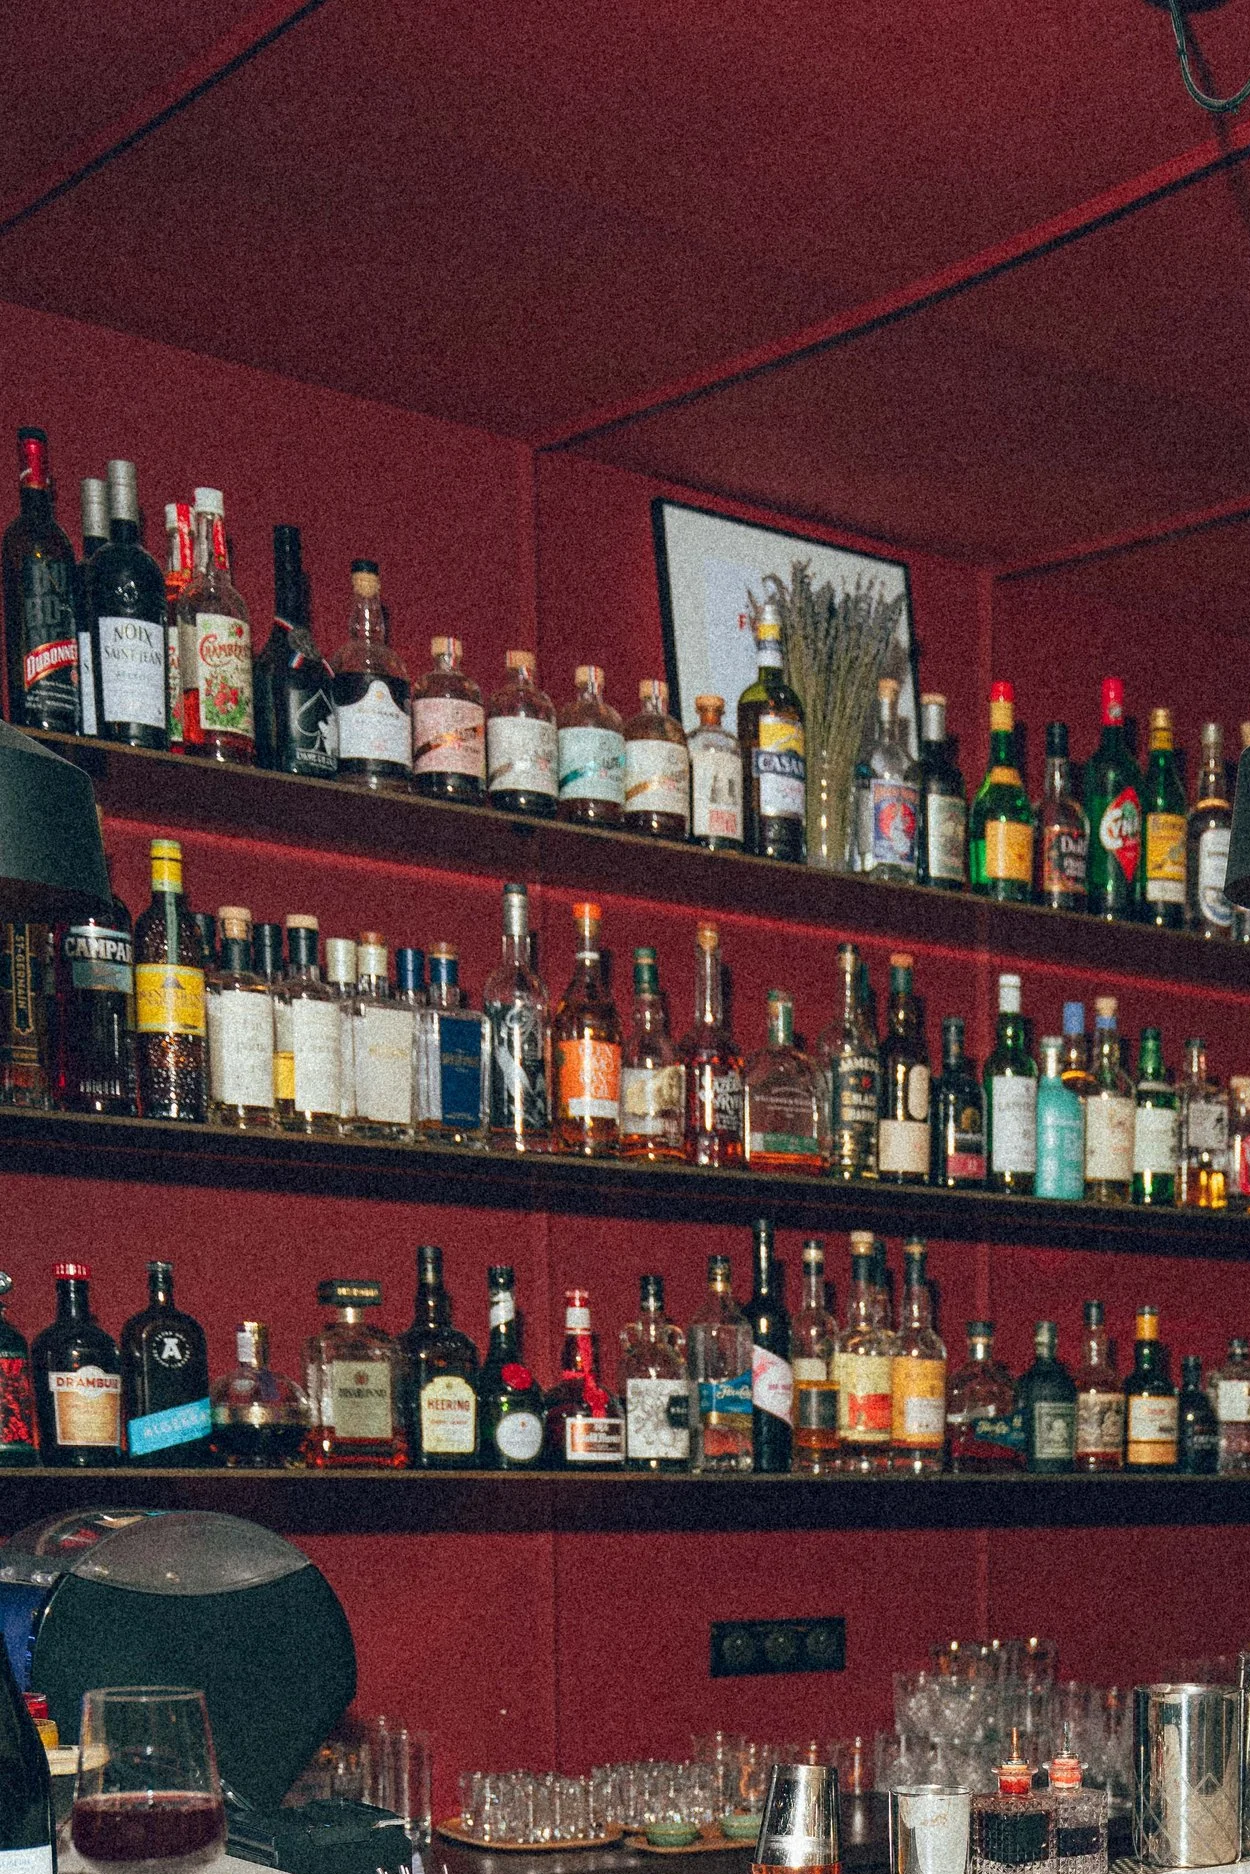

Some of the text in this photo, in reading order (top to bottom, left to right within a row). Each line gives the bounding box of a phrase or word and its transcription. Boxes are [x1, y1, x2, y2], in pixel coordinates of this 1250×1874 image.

[114, 623, 153, 648] NOIX
[27, 644, 78, 680] DUBONNE
[161, 1338, 182, 1360] A
[56, 1376, 118, 1389] DRAMBUIE
[427, 1398, 470, 1411] HEERING
